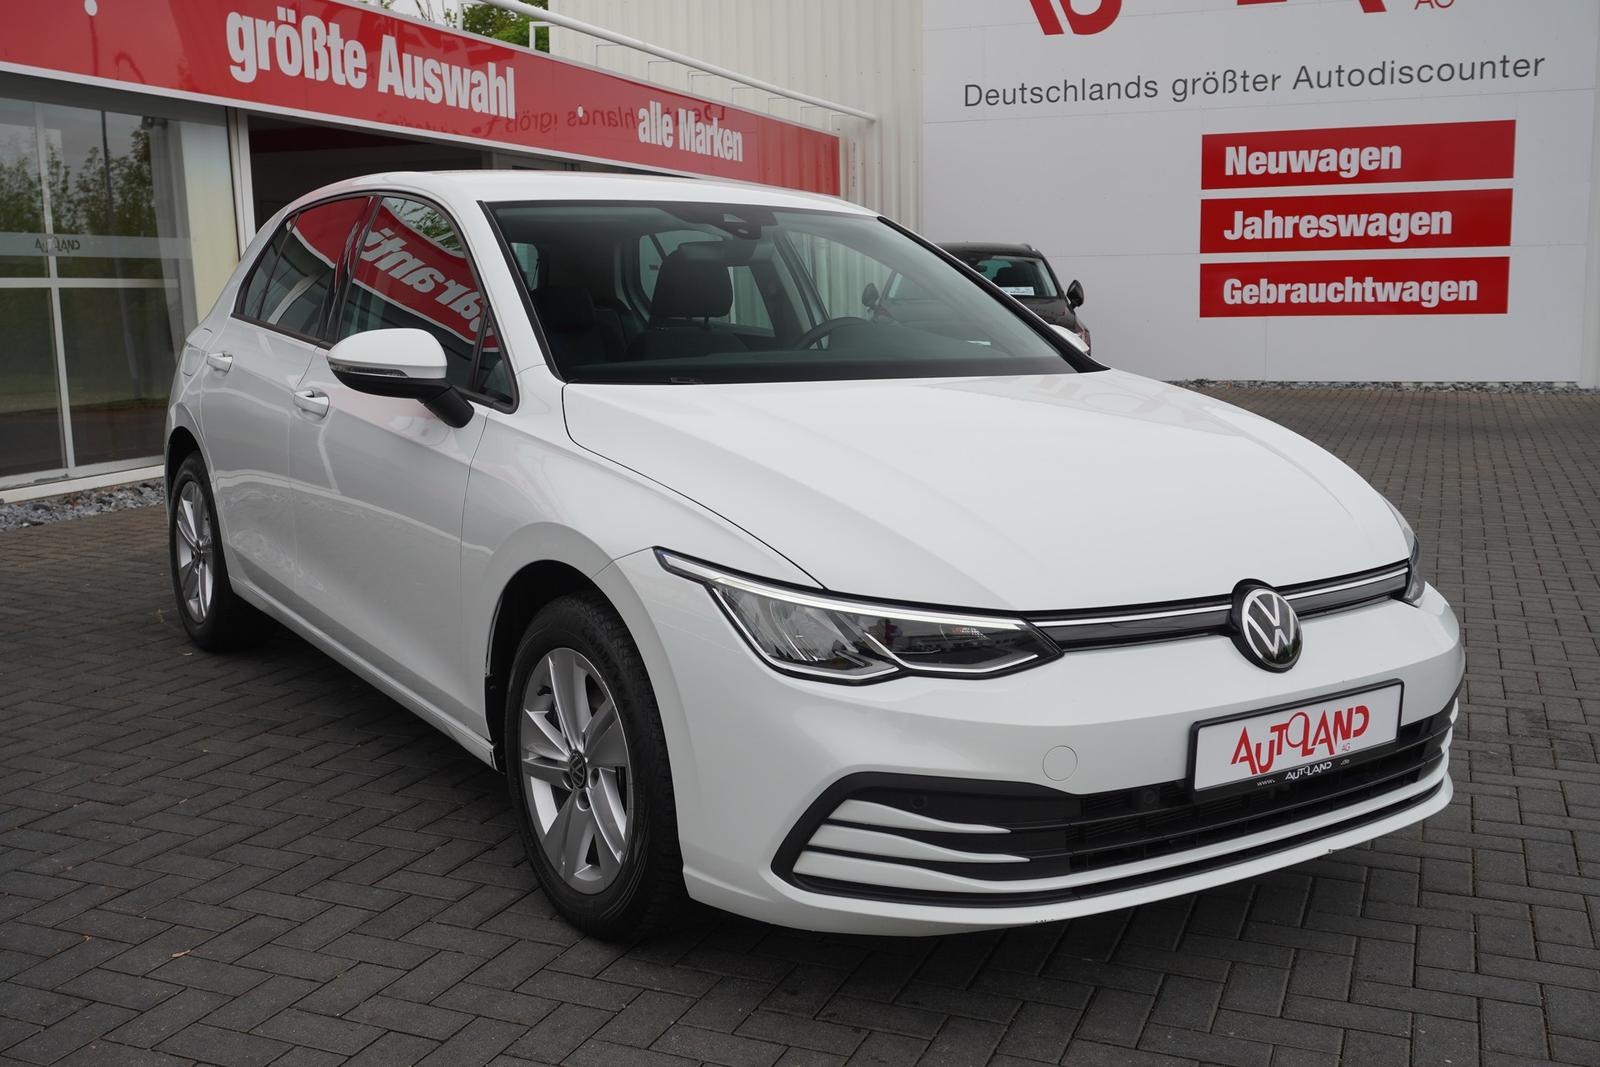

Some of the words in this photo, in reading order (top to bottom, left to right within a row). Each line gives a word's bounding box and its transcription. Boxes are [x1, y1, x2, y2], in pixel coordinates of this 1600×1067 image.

[226, 6, 368, 89] größte
[377, 34, 516, 120] Auswahl
[638, 100, 675, 148] alle
[678, 107, 743, 162] Marken
[964, 75, 1159, 107] Deutschlands
[1171, 70, 1282, 103] größter
[1291, 55, 1546, 90] Autodiscounter
[1225, 145, 1402, 178] Neuwagen
[1223, 210, 1452, 243] Jahreswagen
[1223, 276, 1478, 308] Gebrauchtwagen
[1231, 704, 1370, 775] AUTOLAND
